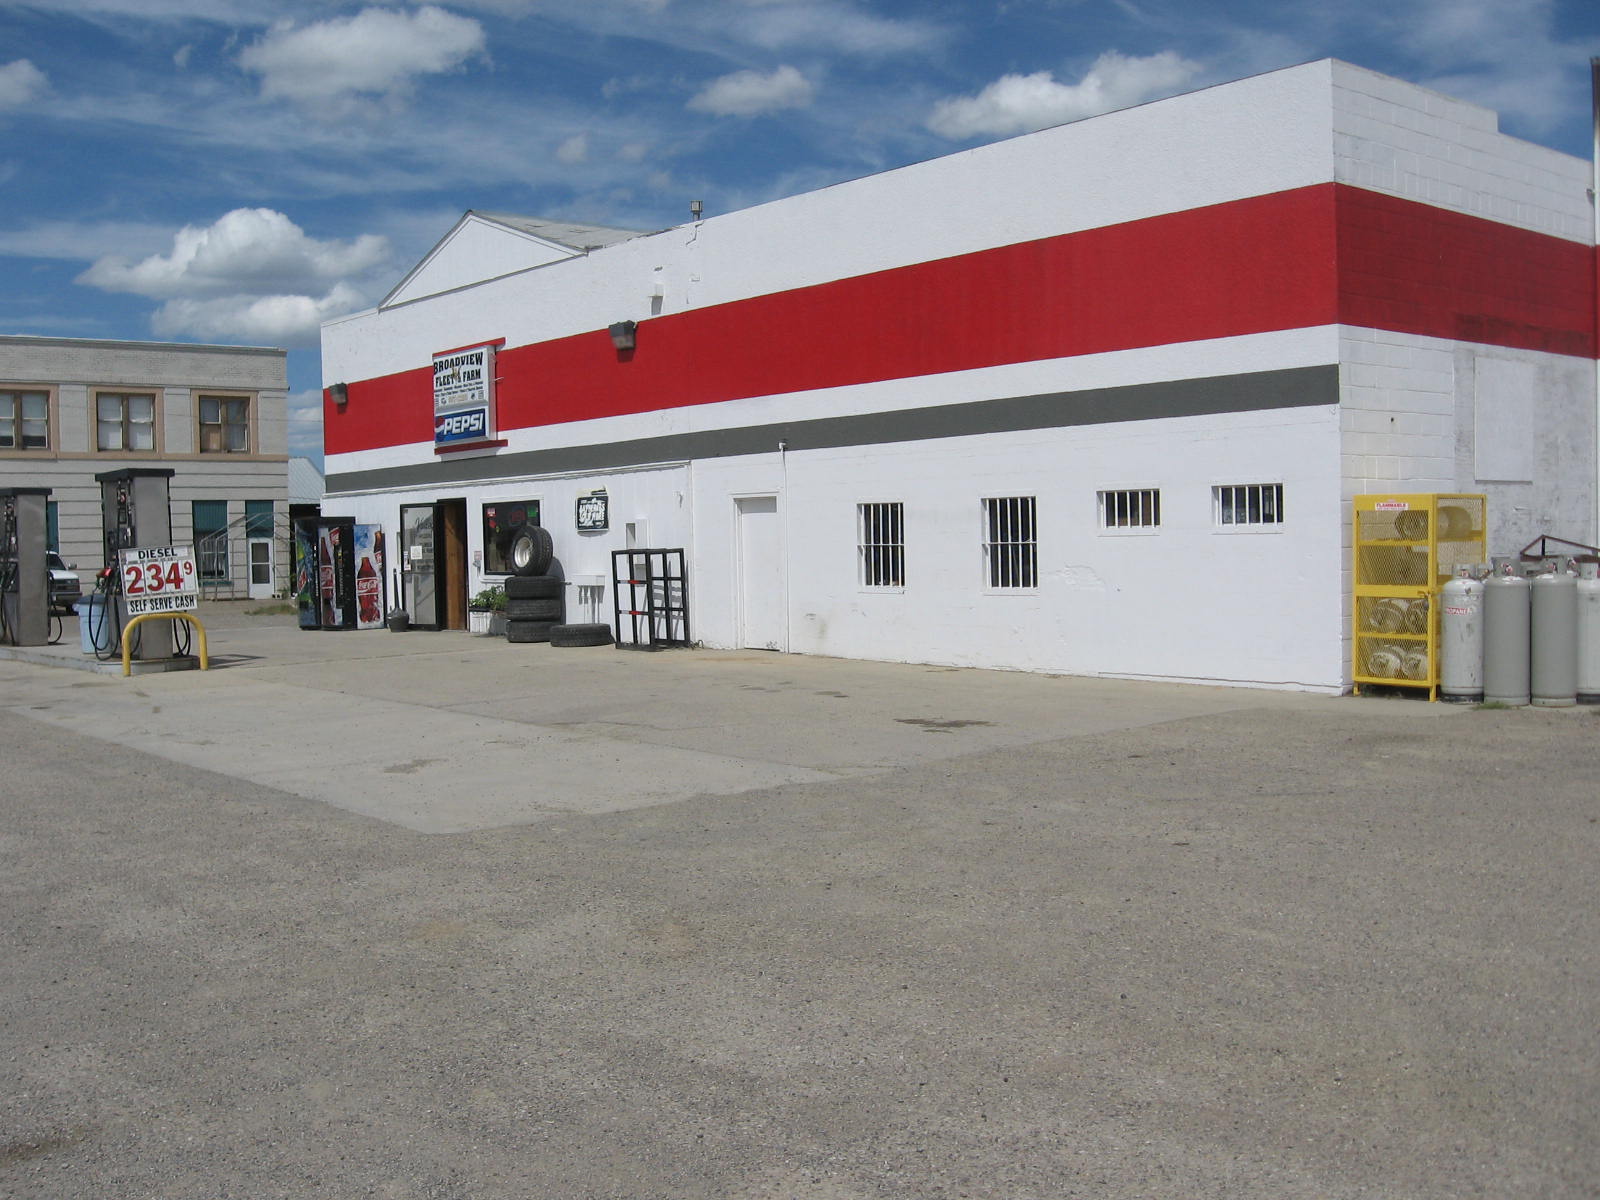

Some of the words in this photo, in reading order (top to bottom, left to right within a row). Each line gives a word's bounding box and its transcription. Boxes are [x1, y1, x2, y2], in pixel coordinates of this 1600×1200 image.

[433, 351, 483, 375] BROADVIEW
[435, 373, 455, 387] FLEET
[462, 368, 481, 382] FARM
[443, 413, 483, 435] PEPSI
[138, 547, 178, 559] DIESEL
[130, 600, 147, 613] SELF
[149, 597, 173, 611] SERVE
[174, 595, 195, 608] CASH
